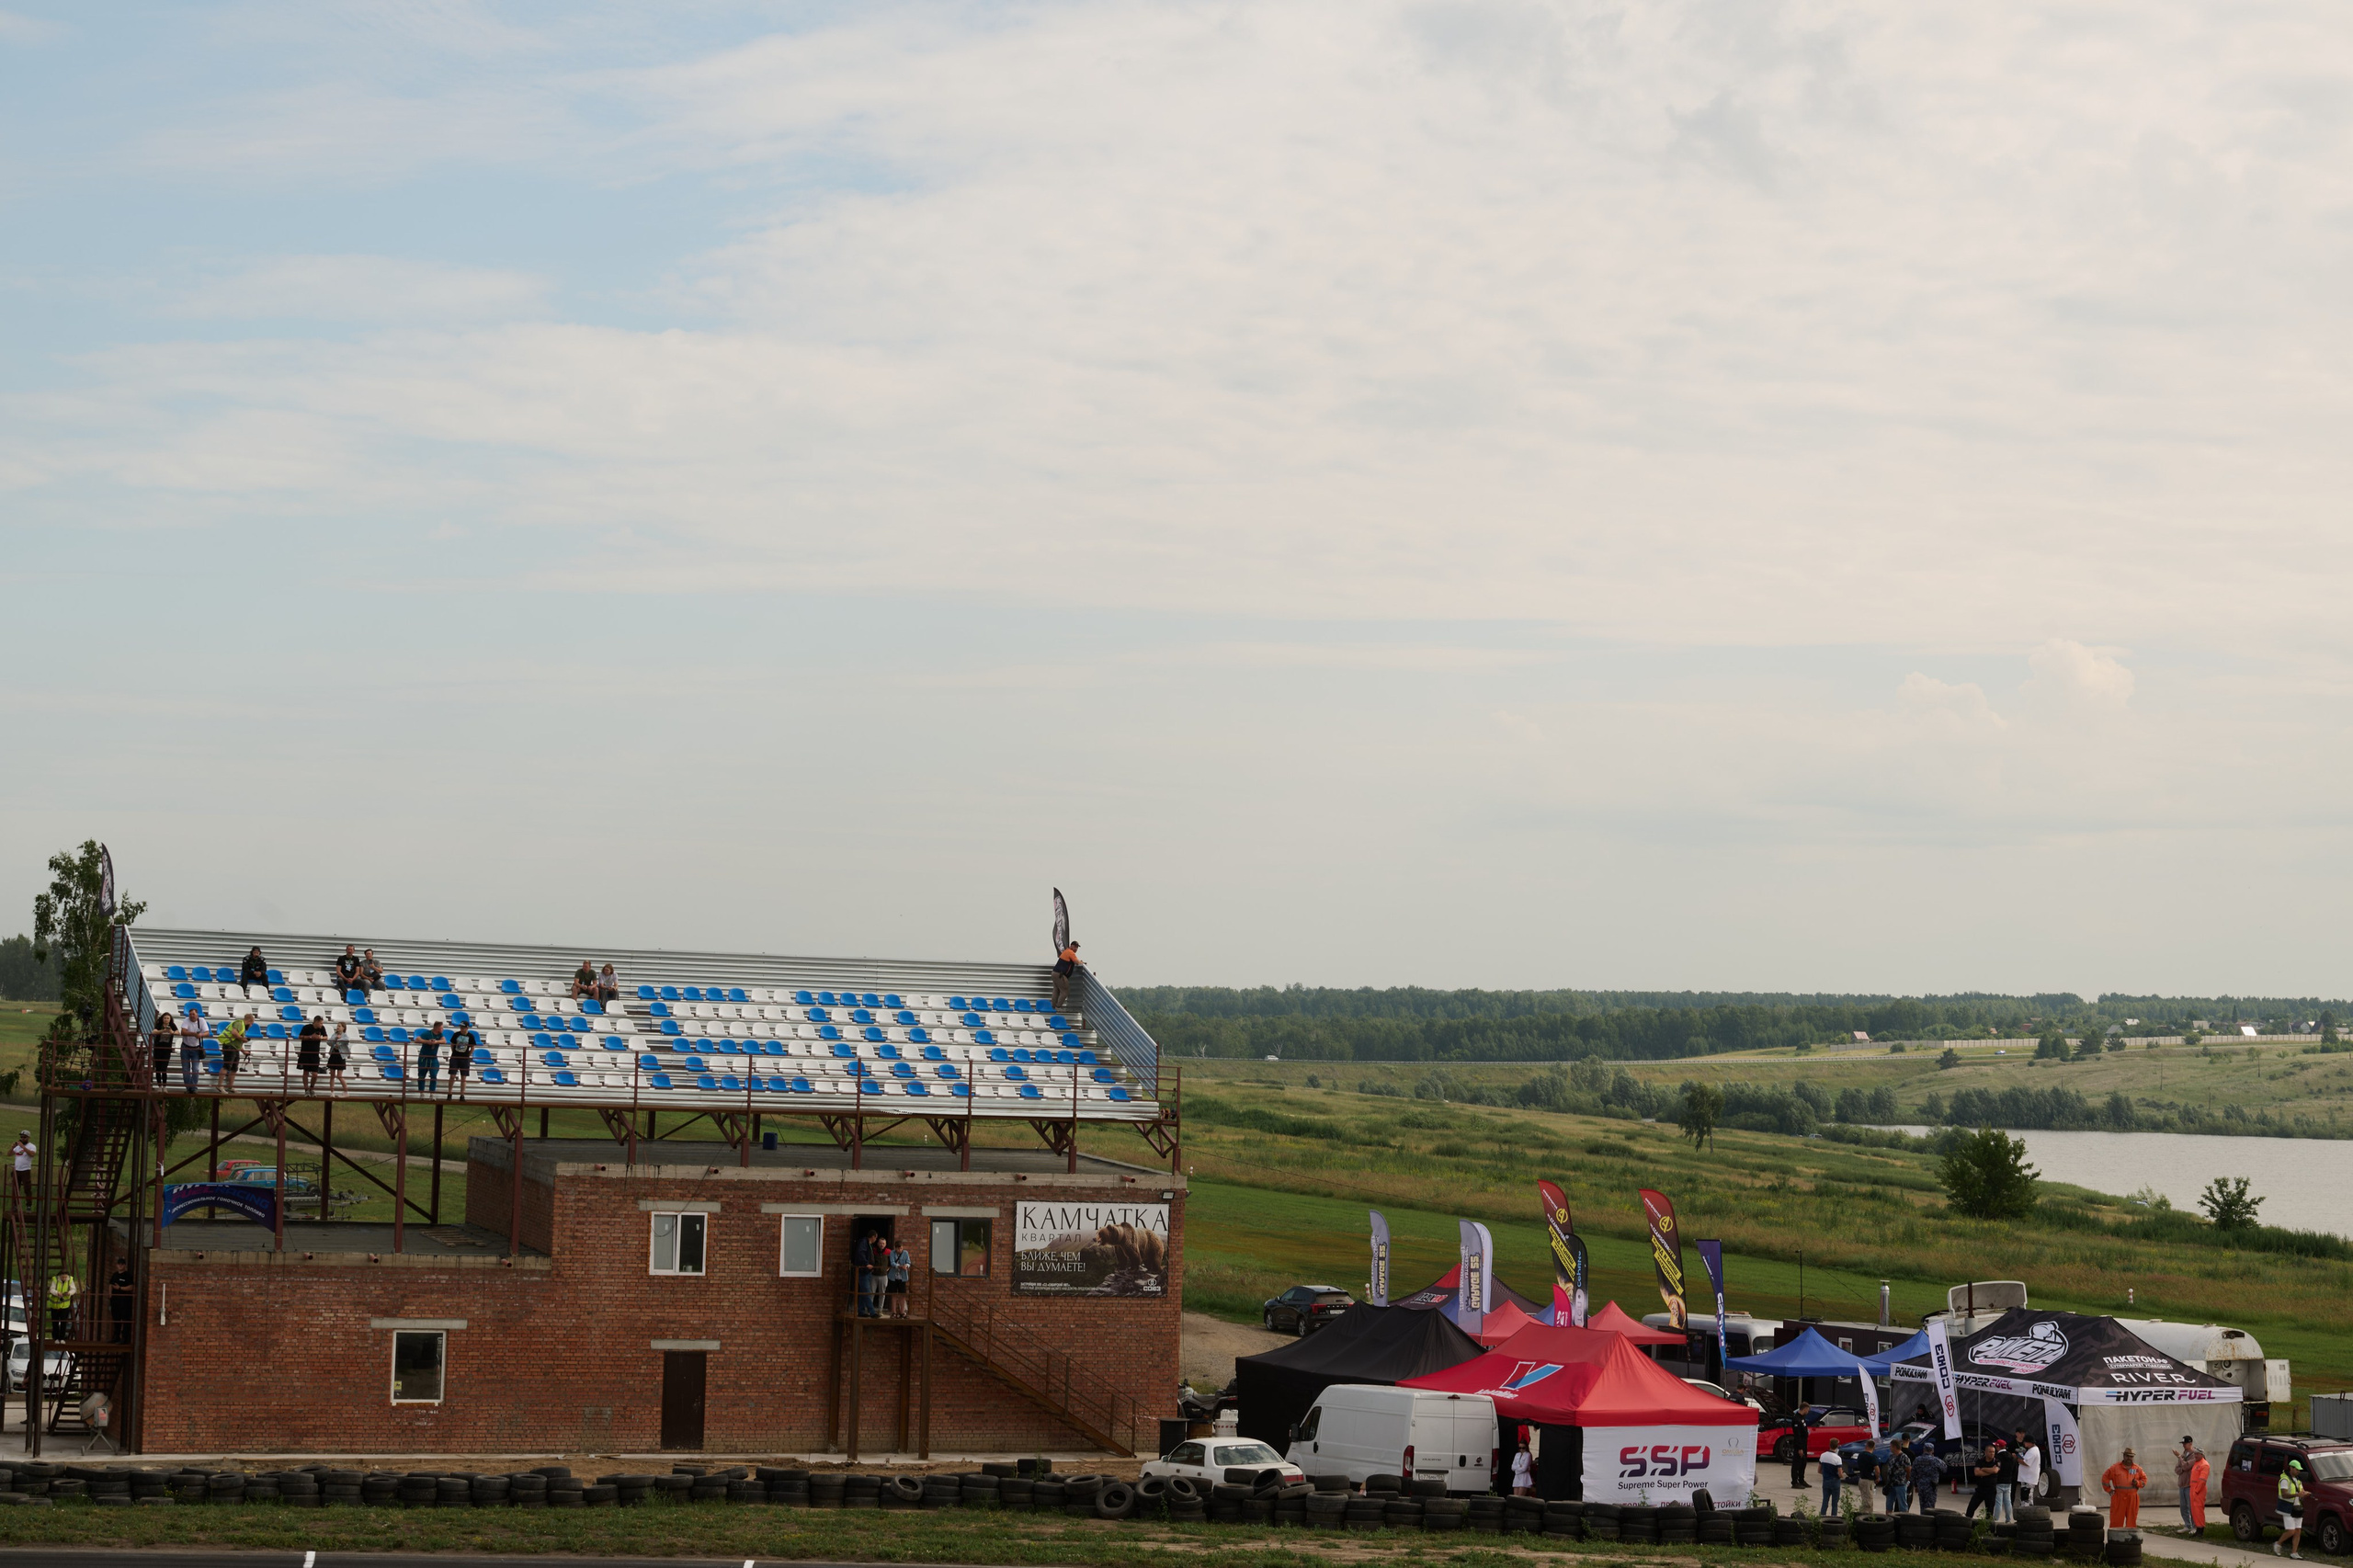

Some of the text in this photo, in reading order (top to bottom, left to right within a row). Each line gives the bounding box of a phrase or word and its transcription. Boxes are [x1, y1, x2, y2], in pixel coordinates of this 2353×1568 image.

[1022, 1206, 1168, 1232] КАМЧАТКА
[1021, 1233, 1082, 1243] КВАРТАЛ
[1021, 1251, 1081, 1262] БЛИЖЕ, ЧЕМ
[1021, 1262, 1086, 1272] ВЫ ДУМАЕТЕ!
[2110, 1372, 2196, 1383] RIVER
[1989, 1379, 2012, 1390] FUEL
[2116, 1390, 2216, 1402] HYPER FUEL
[1619, 1445, 1711, 1478] SSP
[1618, 1480, 1709, 1490] Supreme Super Power
